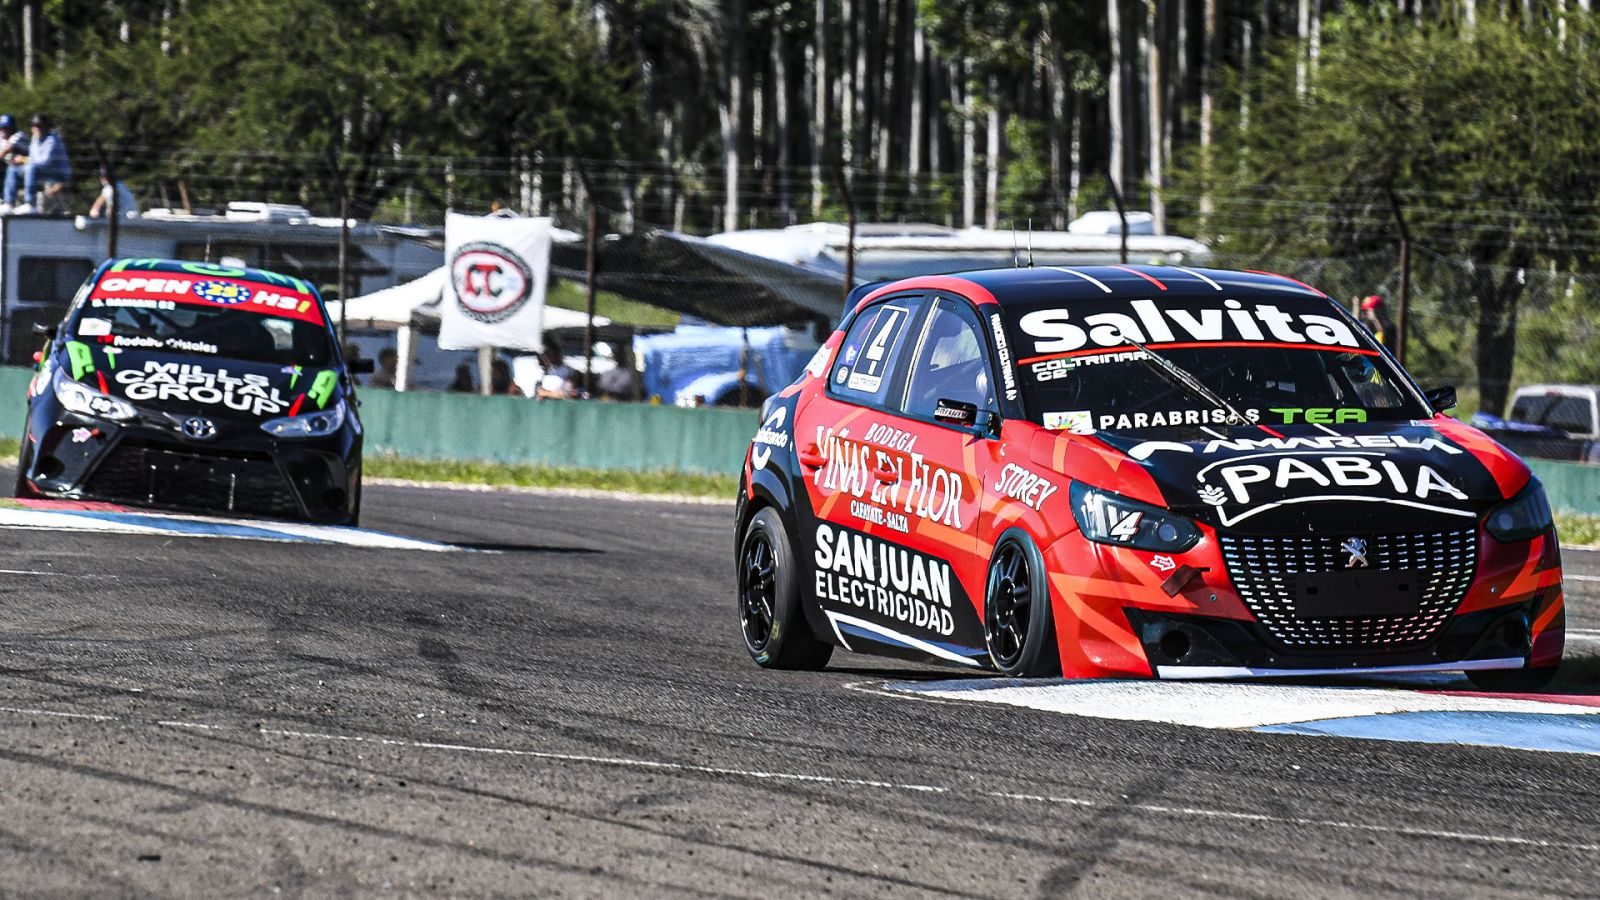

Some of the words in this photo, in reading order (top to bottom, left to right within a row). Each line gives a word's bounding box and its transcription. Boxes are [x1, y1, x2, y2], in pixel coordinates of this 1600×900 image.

[101, 277, 191, 295] OPEN
[865, 309, 900, 376] 4
[1018, 298, 1360, 354] Salvita
[144, 361, 270, 388] MILLS
[1032, 351, 1153, 374] COLTRINAR
[1036, 368, 1068, 382] C2
[115, 369, 290, 407] CAPITAL
[125, 382, 281, 417] GROUP
[1269, 407, 1367, 425] TEA
[864, 422, 918, 454] BODEGA
[871, 450, 904, 509] EN
[904, 452, 963, 530] FLOR
[994, 462, 1059, 512] STOREY
[1220, 456, 1470, 504] PABIA
[1110, 511, 1144, 542] 4
[814, 523, 876, 582] SAN
[878, 542, 952, 609] JUAN
[815, 569, 955, 636] ELECTRICIDAD
